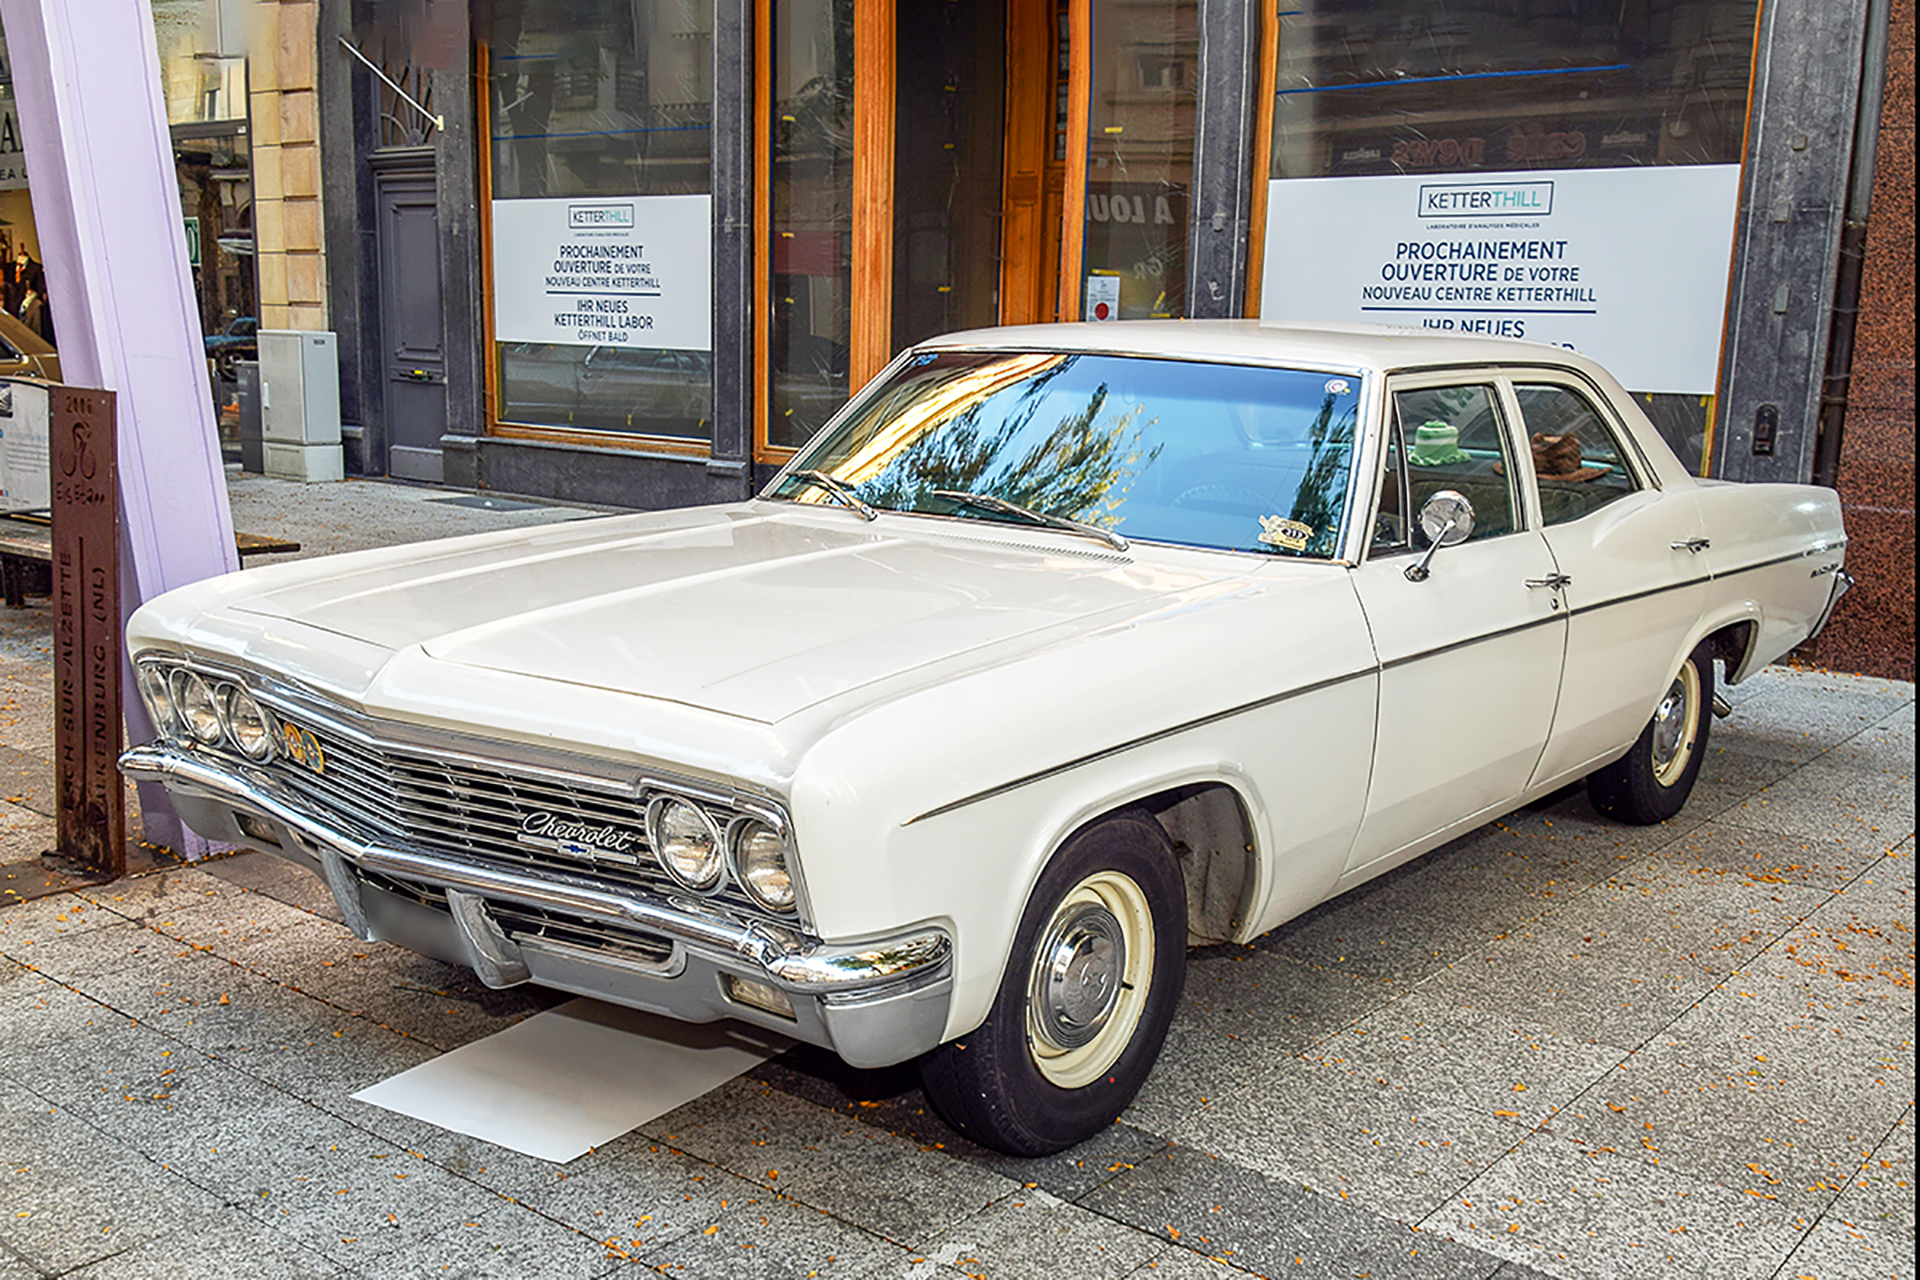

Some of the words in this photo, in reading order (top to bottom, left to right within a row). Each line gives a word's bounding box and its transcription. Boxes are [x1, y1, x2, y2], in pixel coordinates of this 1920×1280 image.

[1428, 190, 1541, 209] KETTERTHILL
[573, 210, 629, 223] KETTERTHILL
[560, 245, 644, 259] PROCHAINEMENT
[1395, 240, 1568, 260] PROCHAINEMENT
[553, 260, 612, 274] OUVERTURE
[614, 263, 624, 274] DE
[626, 263, 651, 275] VOTRE
[1381, 263, 1499, 281] OUVERTURE
[1503, 267, 1524, 282] DE
[1529, 267, 1580, 282] VOTRE
[545, 276, 581, 287] NOUVEAU
[582, 276, 610, 288] CENTRE
[612, 277, 661, 289] KETTERTHILL
[1362, 286, 1432, 301] NOUVEAU
[1435, 286, 1493, 301] CENTRE
[1496, 287, 1598, 303] KETTERTHILL
[577, 299, 594, 312] IHR
[596, 299, 629, 314] NEUES
[554, 313, 617, 328] KETTERTHILL
[618, 315, 654, 329] LABOR
[577, 329, 606, 341] ÖFFNET
[608, 331, 629, 342] BALD
[92, 567, 107, 623] (NL)
[522, 811, 638, 850] Chevrolet
